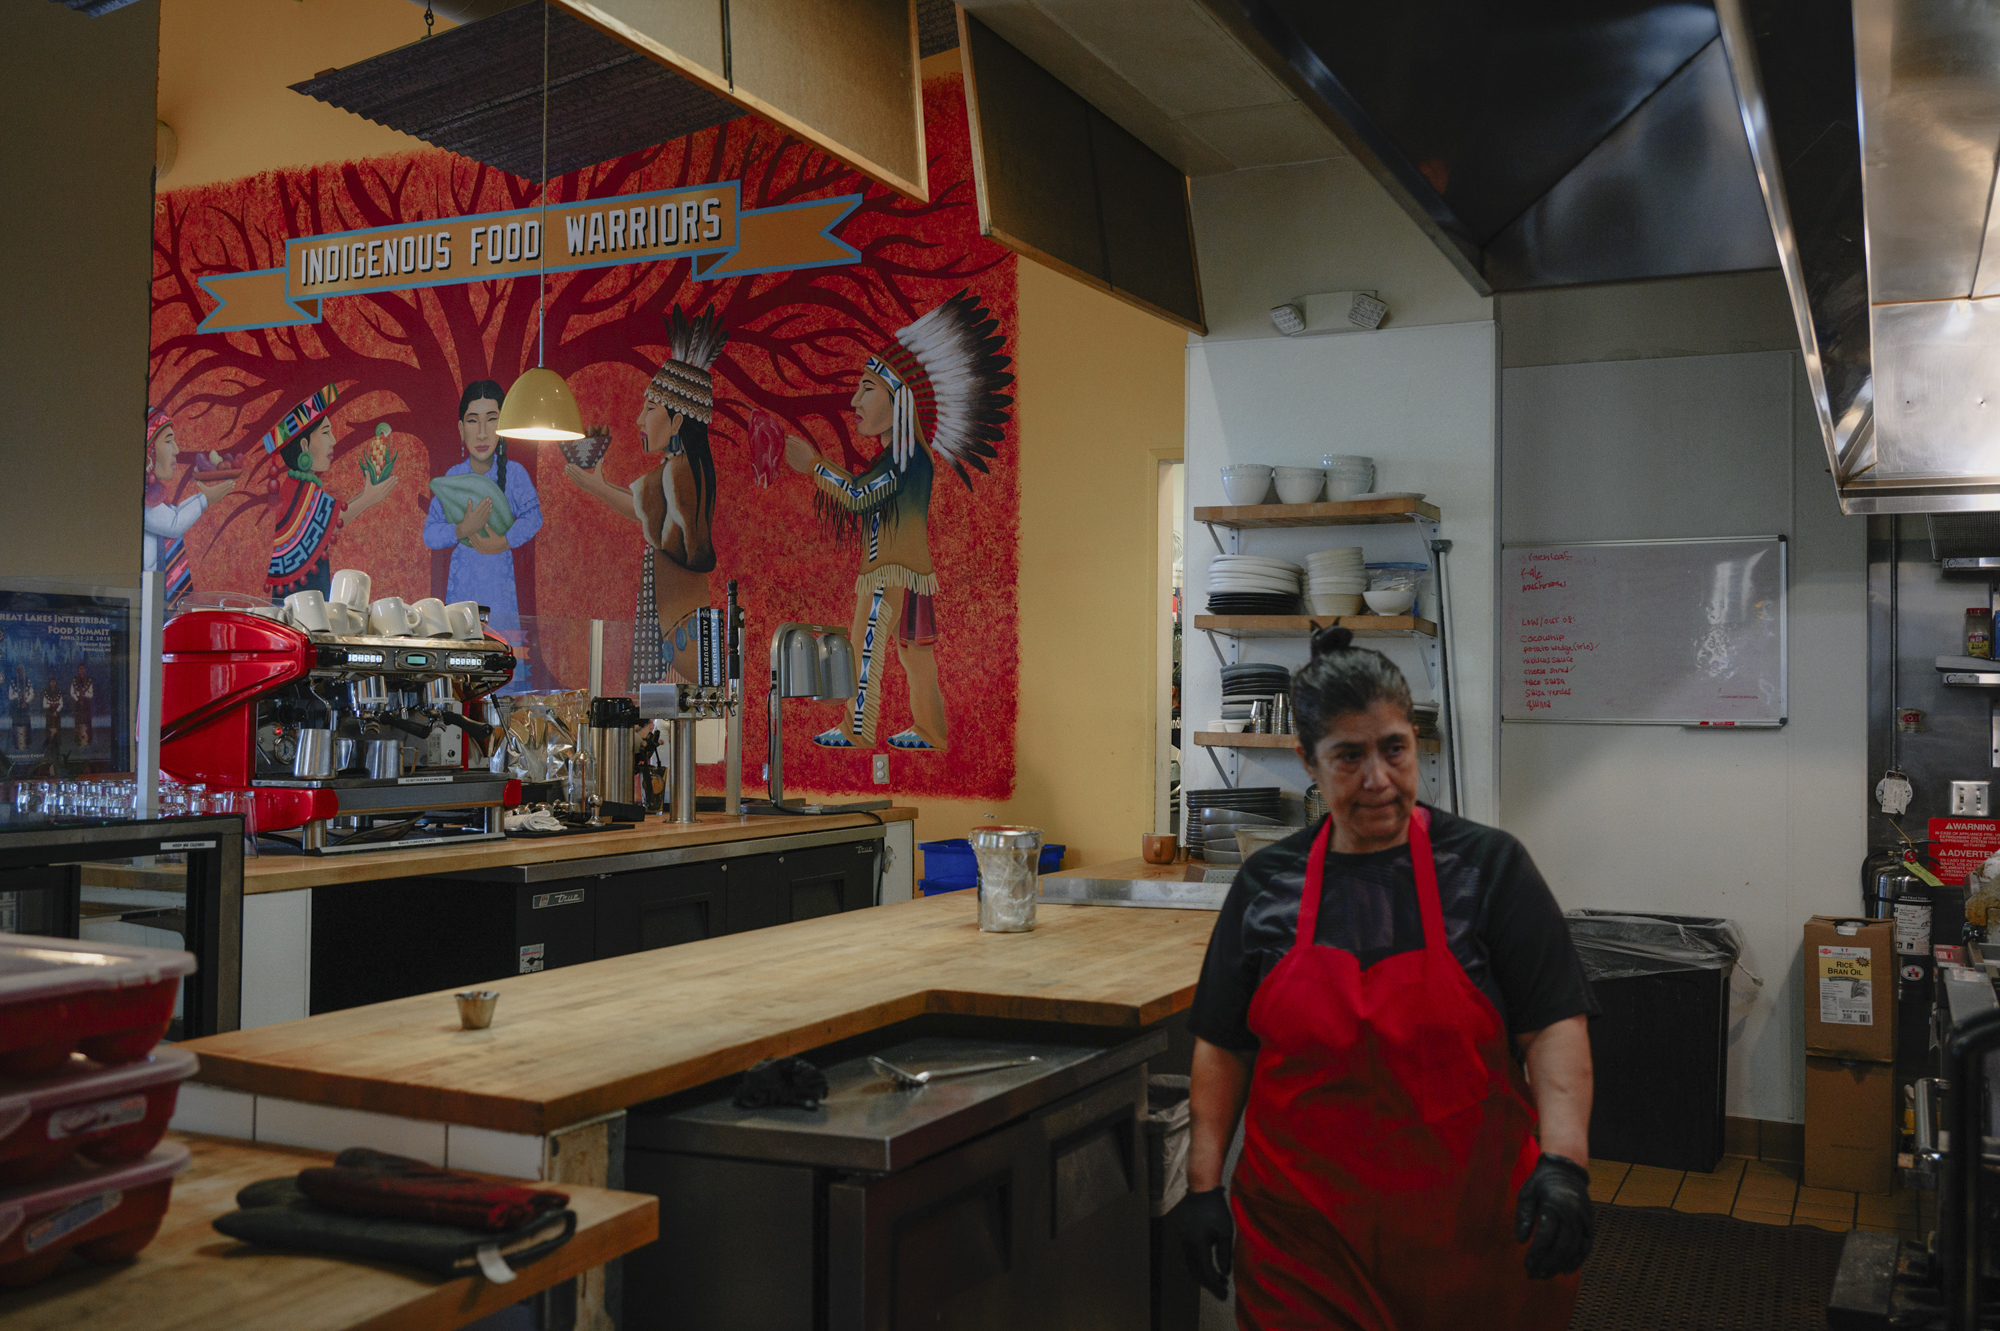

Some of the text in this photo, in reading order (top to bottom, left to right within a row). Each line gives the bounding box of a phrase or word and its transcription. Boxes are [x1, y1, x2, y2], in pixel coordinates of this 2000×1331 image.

[301, 197, 721, 286] INDIGENOUS FOOD WARRIORS
[0, 613, 110, 625] REAT LAKES INTERTRIBAL
[48, 625, 110, 636] FOOD SUMMIT
[1952, 823, 1996, 831] WARNING
[855, 845, 873, 854] True
[554, 894, 580, 902] True
[1836, 961, 1854, 969] RICE
[1827, 967, 1863, 976] BRAN OIL
